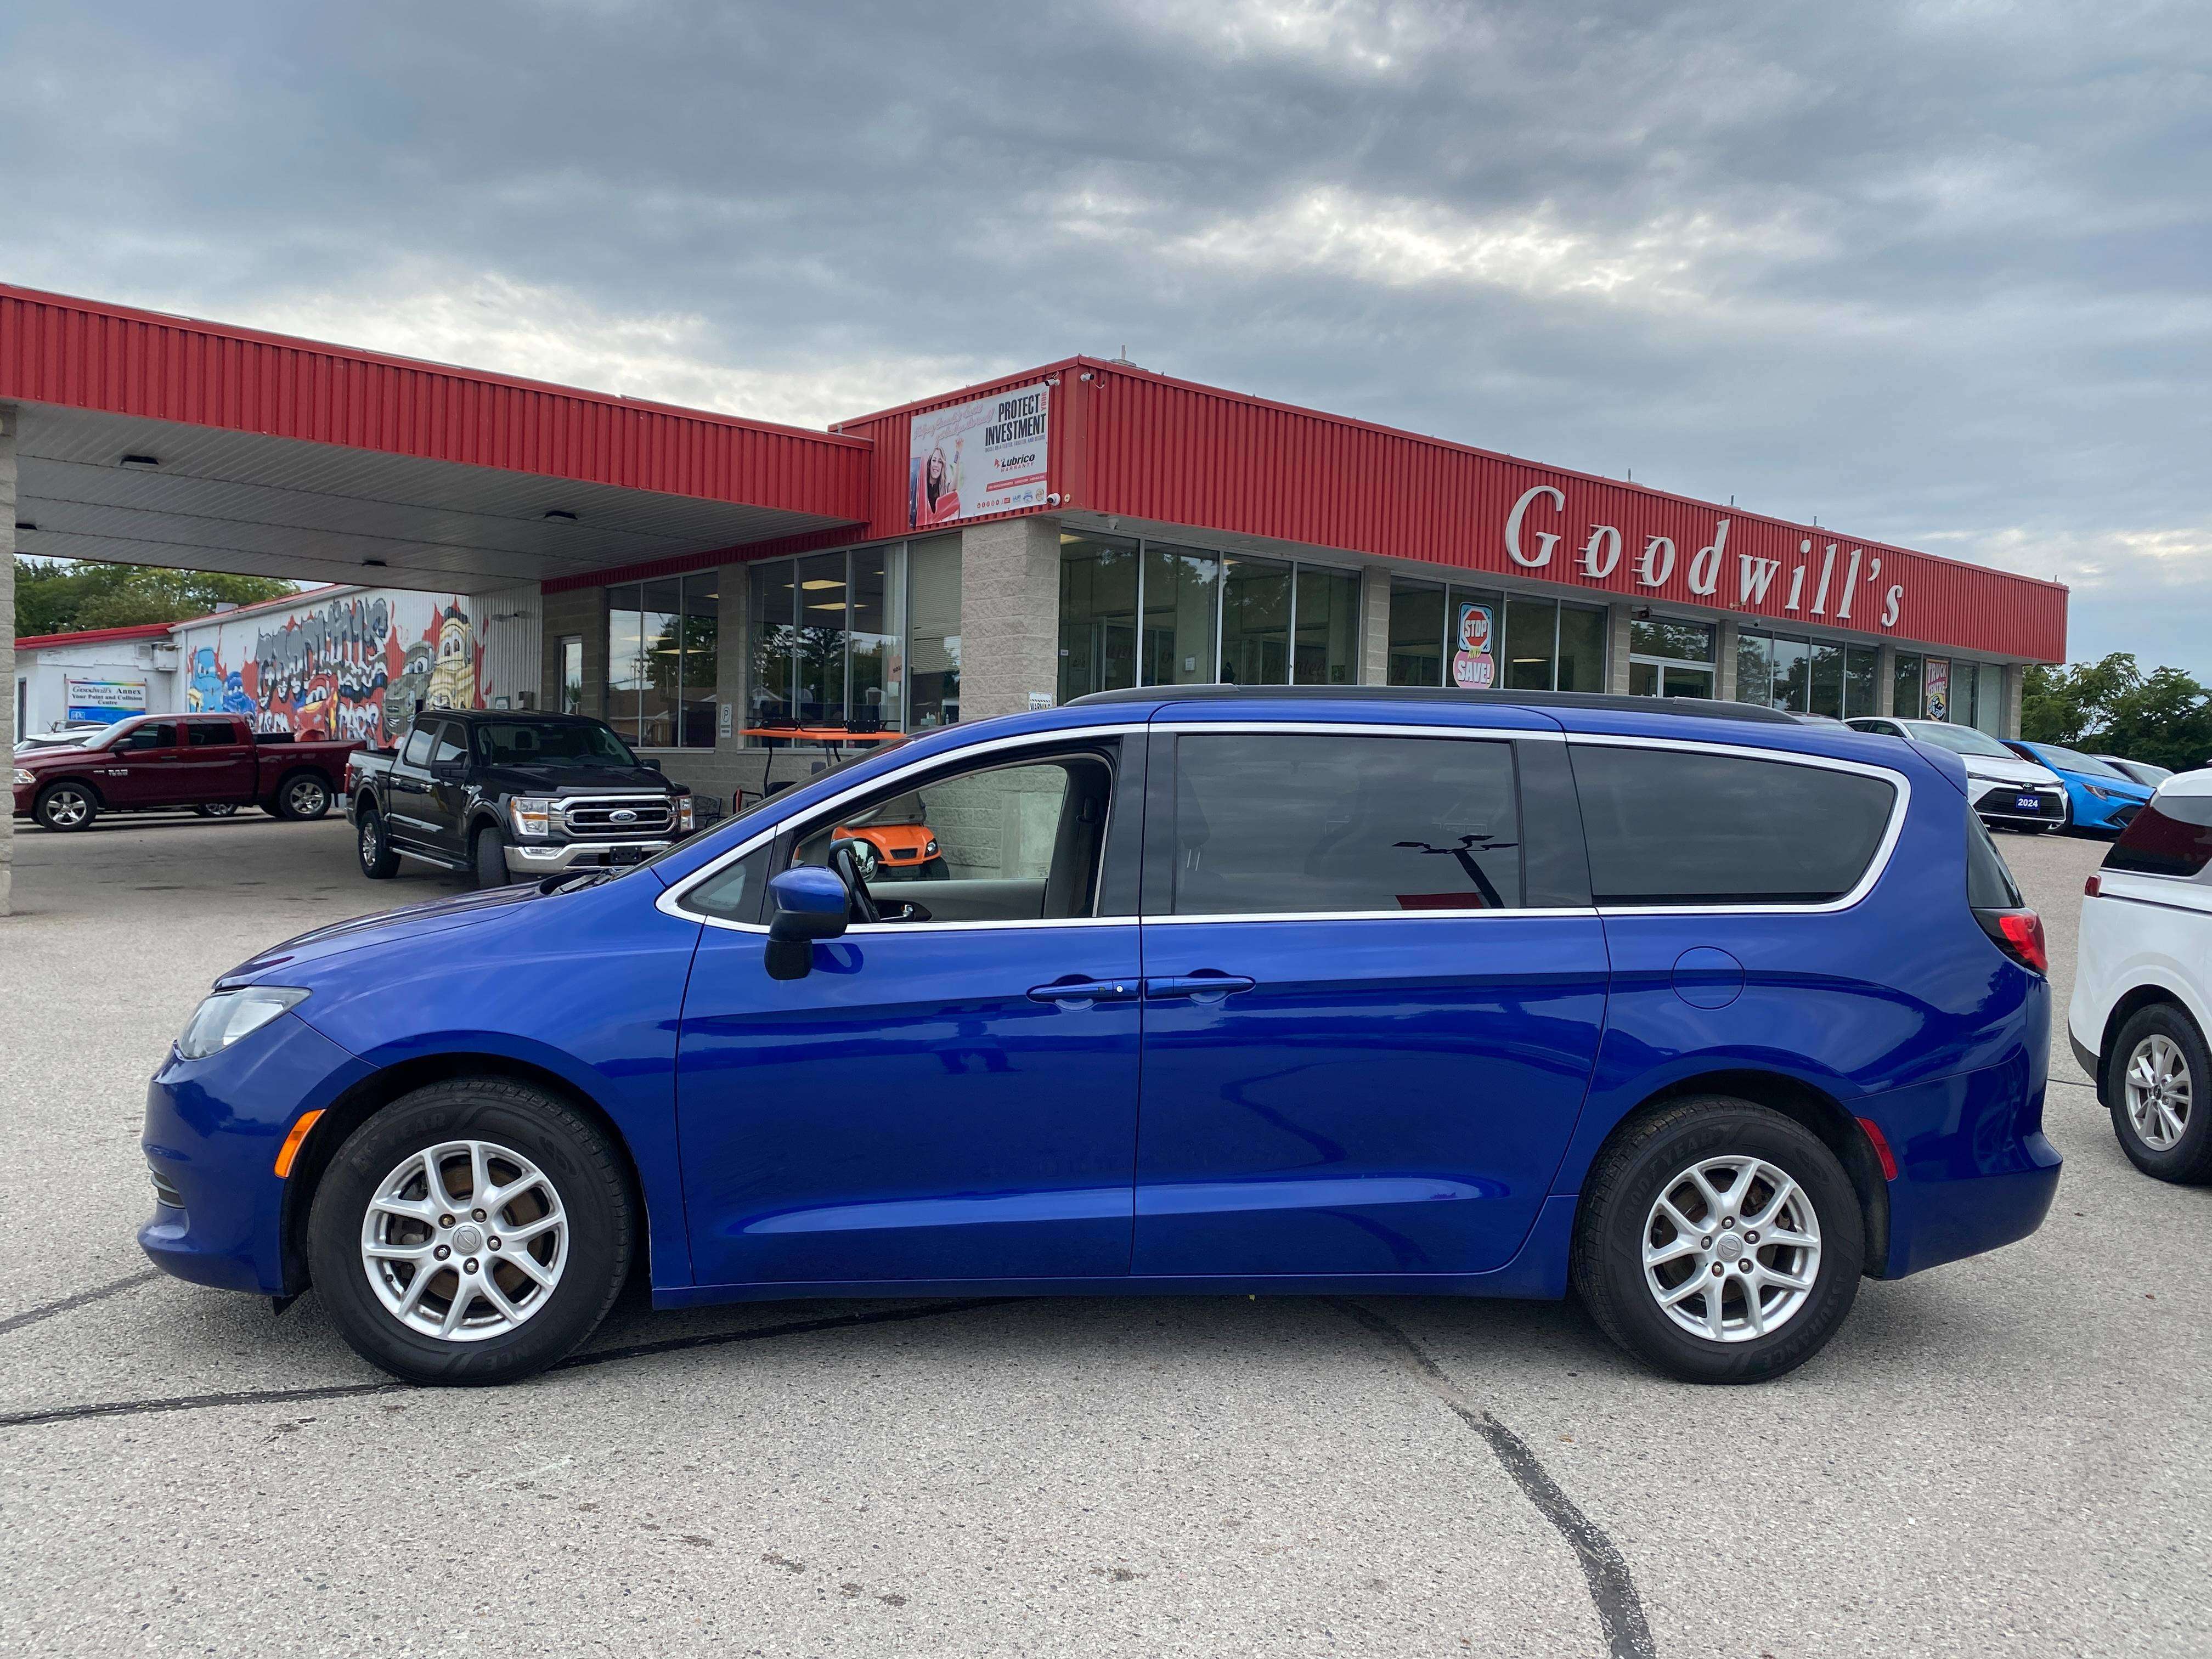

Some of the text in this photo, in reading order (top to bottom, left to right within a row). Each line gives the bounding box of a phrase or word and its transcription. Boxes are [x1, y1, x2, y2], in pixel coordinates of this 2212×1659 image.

[998, 393, 1040, 422] PROTECT
[985, 413, 1046, 446] INVESTMENT
[1001, 454, 1035, 468] Lubrico
[1001, 461, 1034, 472] WARRANTY
[1505, 486, 1903, 627] Goodwill's
[1465, 619, 1488, 637] STOP
[1468, 647, 1481, 659] AND
[893, 664, 901, 673] SOL
[1457, 660, 1491, 684] SAVE!
[1928, 662, 1946, 684] TRUCK
[1928, 681, 1945, 698] CENTRE
[2018, 798, 2038, 808] 2024
